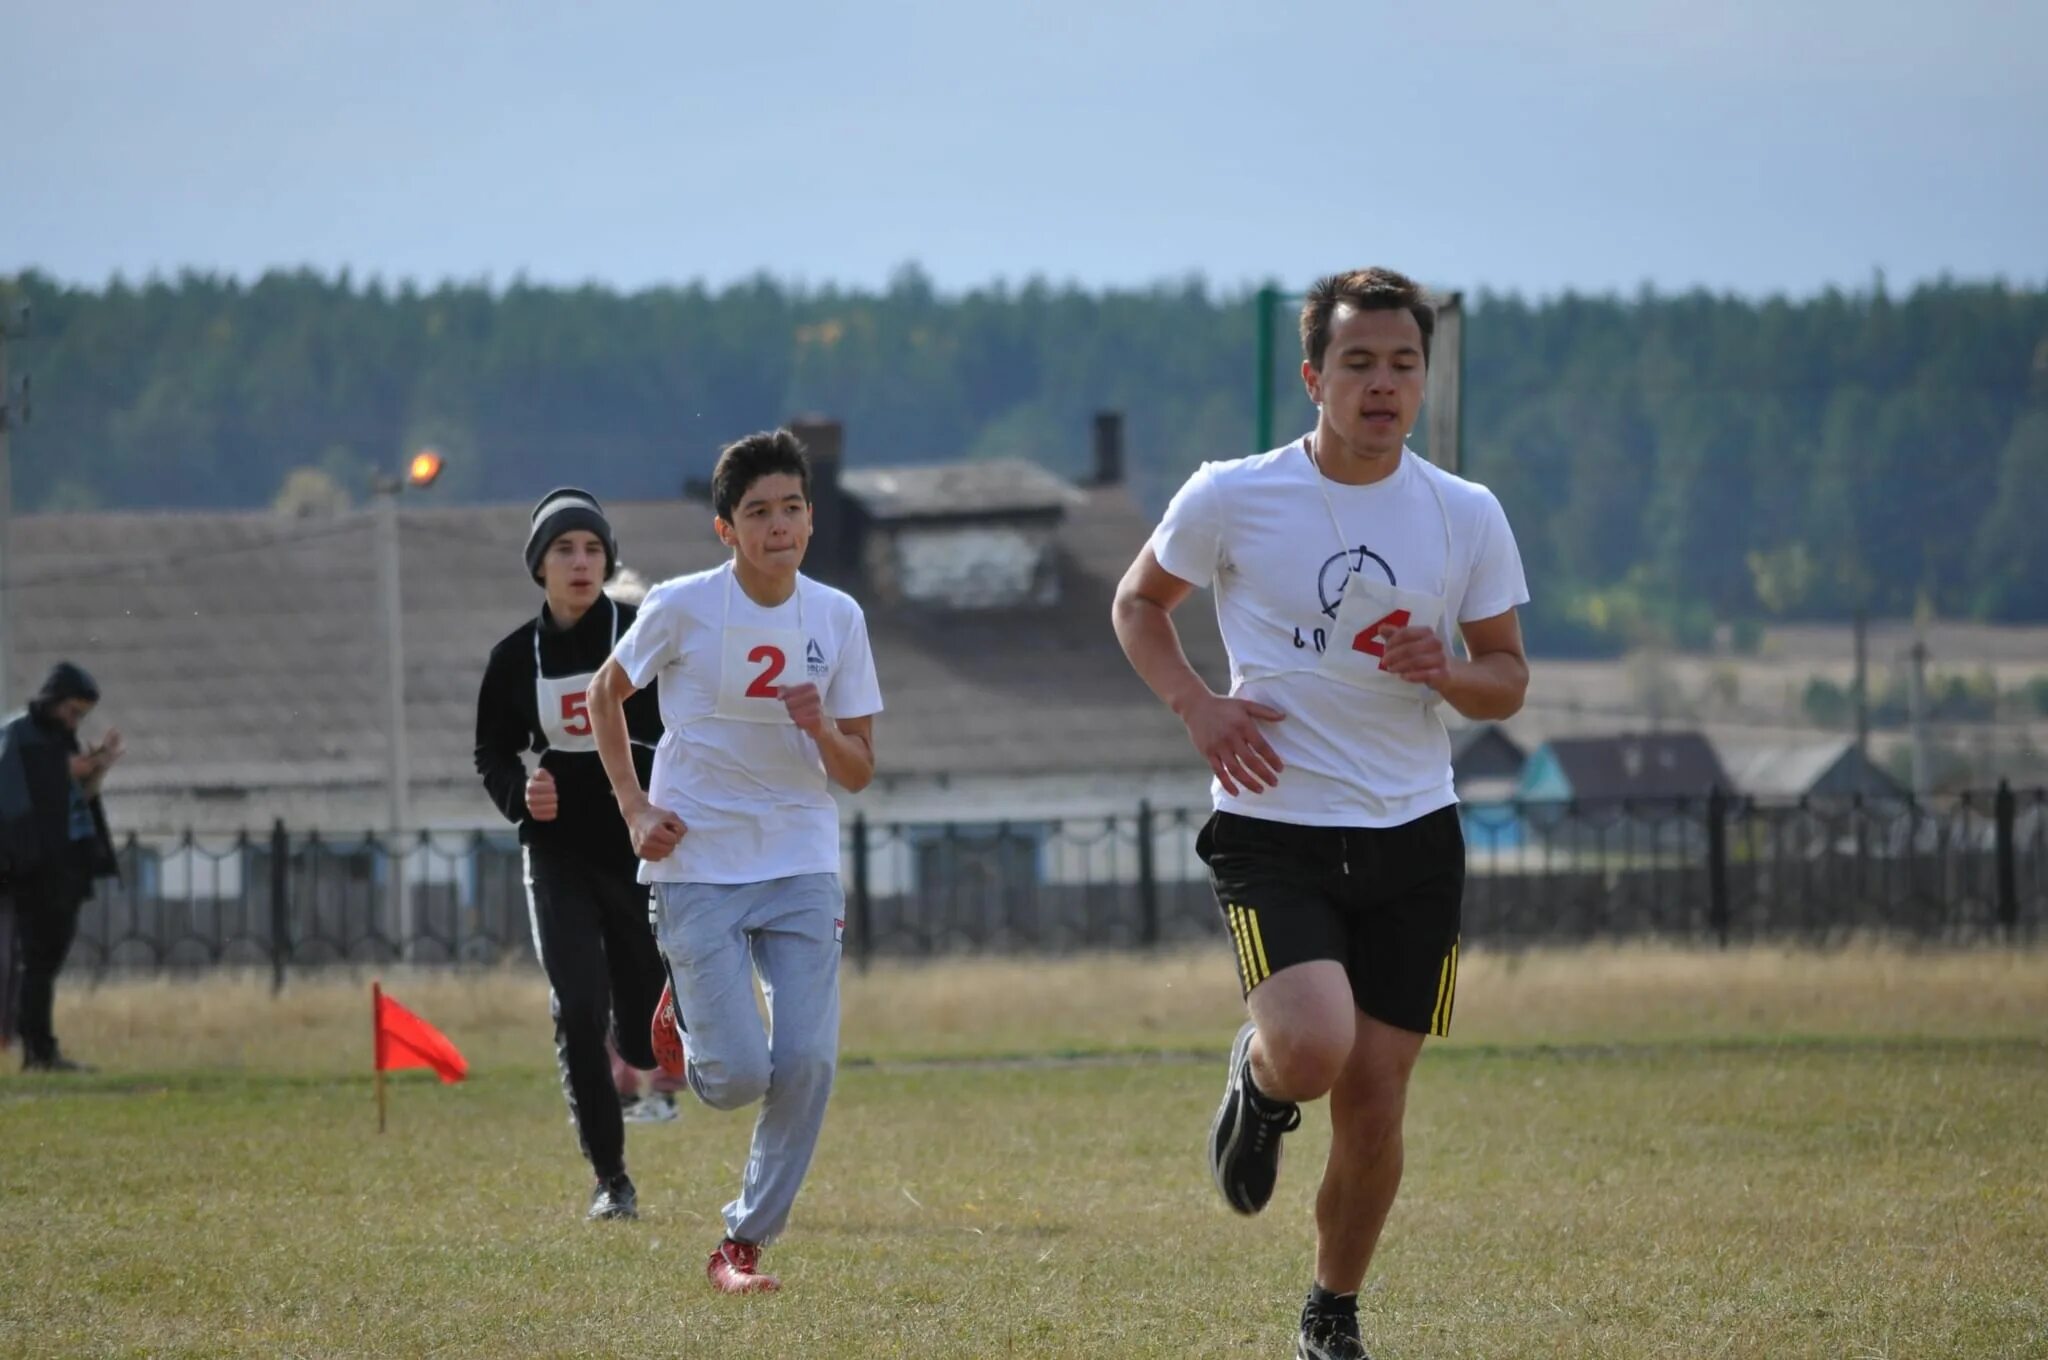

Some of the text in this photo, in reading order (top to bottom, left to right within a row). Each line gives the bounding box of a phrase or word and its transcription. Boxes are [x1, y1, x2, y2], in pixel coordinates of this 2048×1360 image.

[1352, 609, 1411, 672] 4
[744, 644, 786, 699] 2
[560, 690, 593, 737] 5
